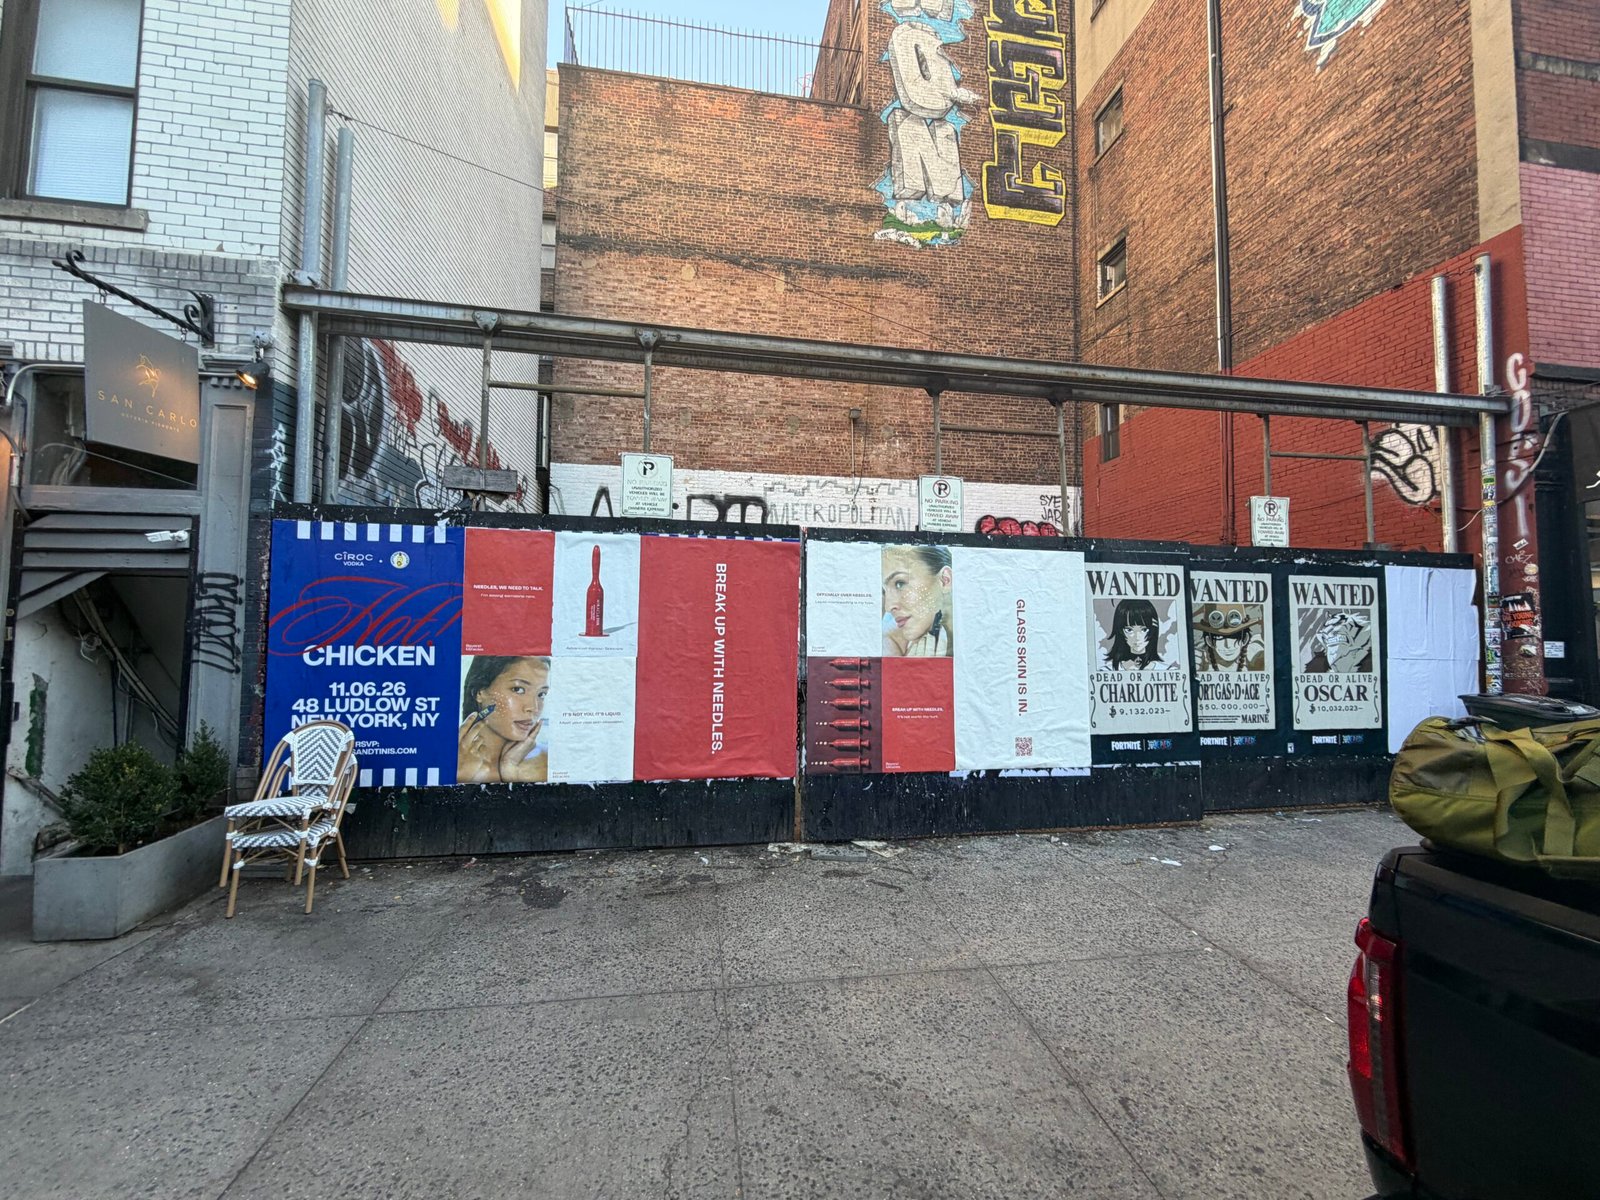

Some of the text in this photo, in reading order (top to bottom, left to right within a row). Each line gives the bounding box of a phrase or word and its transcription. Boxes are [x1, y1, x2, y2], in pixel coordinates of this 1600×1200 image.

[98, 390, 197, 428] SAN CARLO
[768, 501, 911, 531] METROPOLITAN
[334, 551, 374, 562] CÎROC
[1086, 570, 1180, 597] WANTED
[1292, 582, 1375, 607] WANTED
[268, 576, 464, 657] Hot!
[302, 645, 436, 667] CHICKEN
[712, 562, 727, 754] BREAK UP WITH NEEDLES.
[1016, 599, 1027, 716] GLASS SKIN IS IN.
[1096, 672, 1181, 682] DEAD OR ALIVE
[1218, 674, 1230, 682] OR
[1237, 674, 1266, 682] ALIVE
[1300, 674, 1372, 683] DEAD OR ALIVE
[328, 682, 406, 696] 11.06.26
[1100, 683, 1178, 703] CHARLOTTE
[1198, 684, 1260, 700] ORTGAS·D·ACE
[1304, 684, 1368, 702] OSCAR
[292, 698, 440, 713] 48 LUDLOW ST
[346, 713, 408, 730] YORK,
[412, 712, 440, 728] NY
[1241, 714, 1269, 724] MARINE
[1111, 740, 1142, 751] FORTNITE
[1200, 737, 1228, 746] FORTNITE
[1312, 735, 1338, 745] FORTNITE
[352, 748, 417, 756] SANDTINIS.COM
